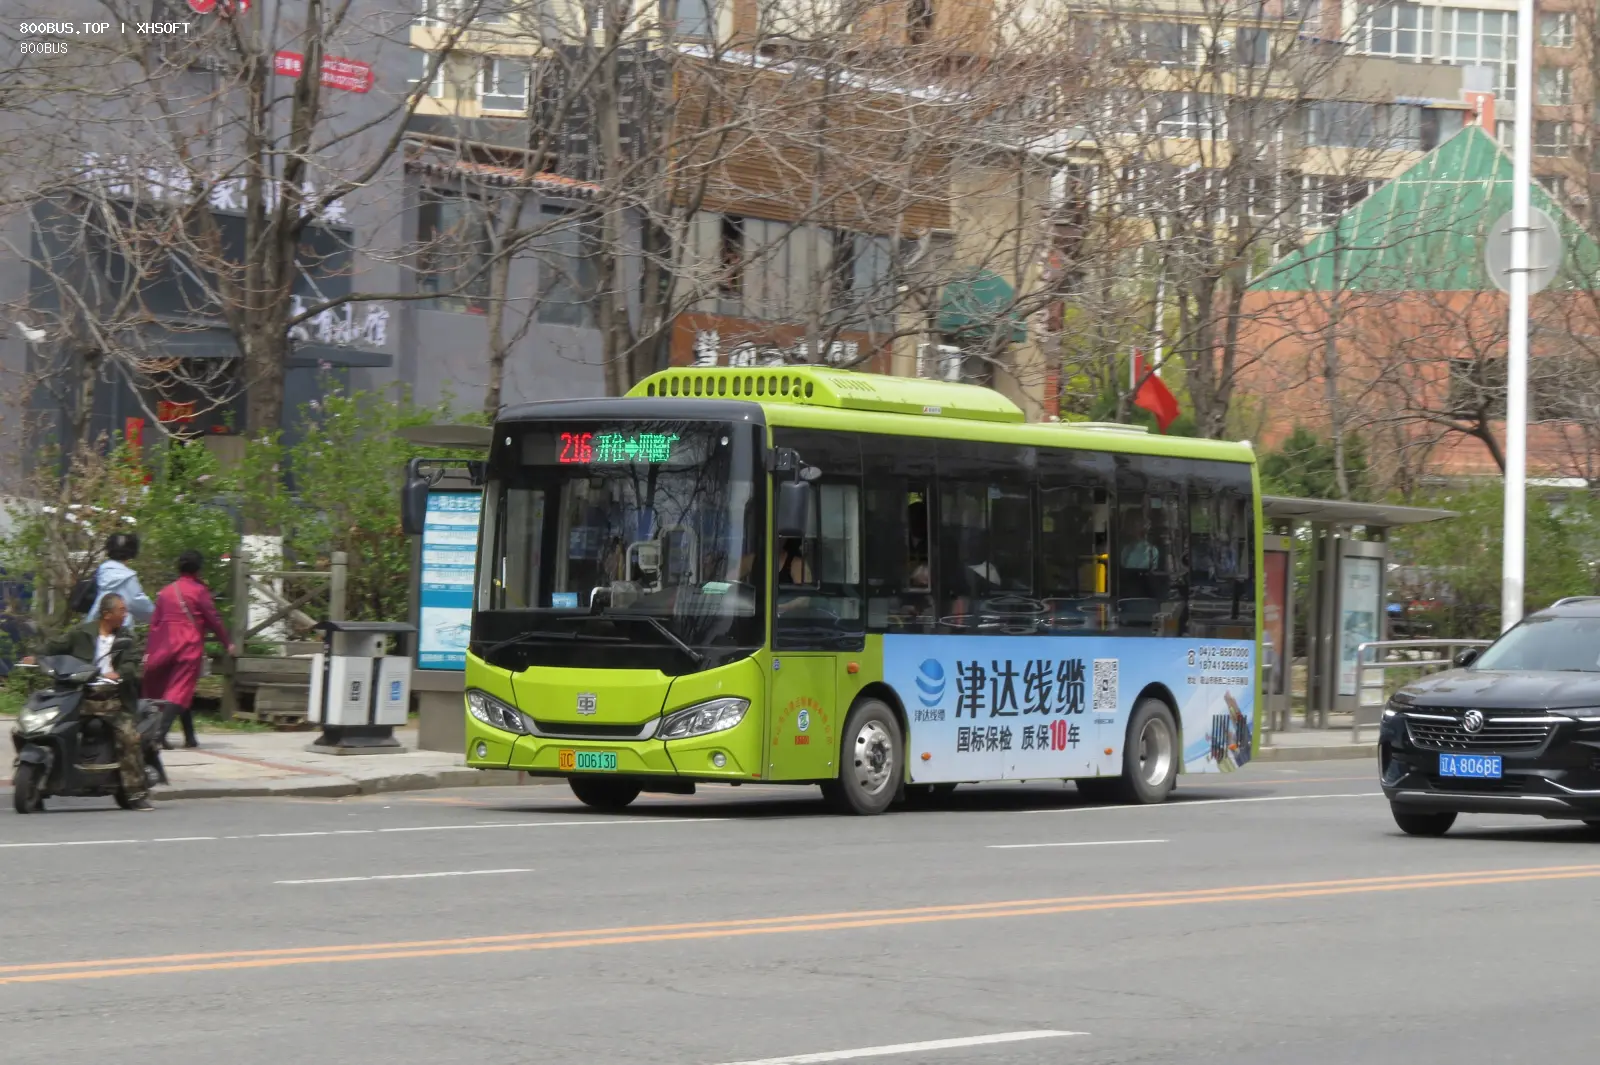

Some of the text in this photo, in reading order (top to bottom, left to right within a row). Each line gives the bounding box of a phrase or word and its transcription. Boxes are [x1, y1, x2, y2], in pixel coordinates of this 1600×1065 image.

[559, 432, 593, 464] 216
[955, 658, 1086, 719] 津达线缆
[914, 708, 946, 722] 津达线缆
[957, 719, 1080, 752] 国标保检 质保10年
